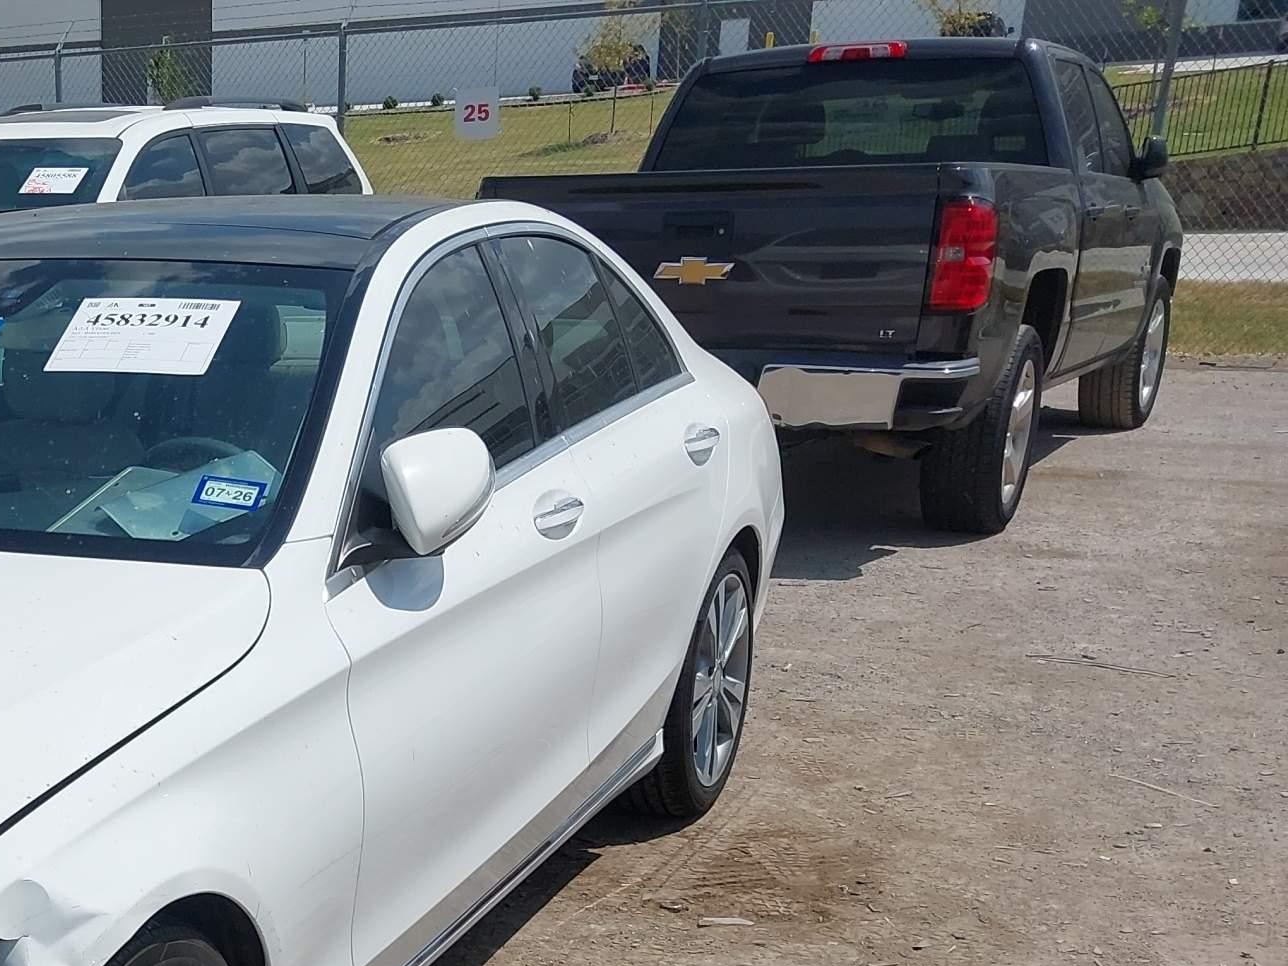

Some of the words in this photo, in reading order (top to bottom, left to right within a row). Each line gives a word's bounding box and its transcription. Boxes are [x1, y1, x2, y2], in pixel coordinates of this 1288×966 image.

[463, 104, 490, 123] 25
[86, 312, 211, 329] 45832914
[879, 329, 896, 339] LT
[204, 486, 226, 498] 07
[231, 490, 254, 502] 26
